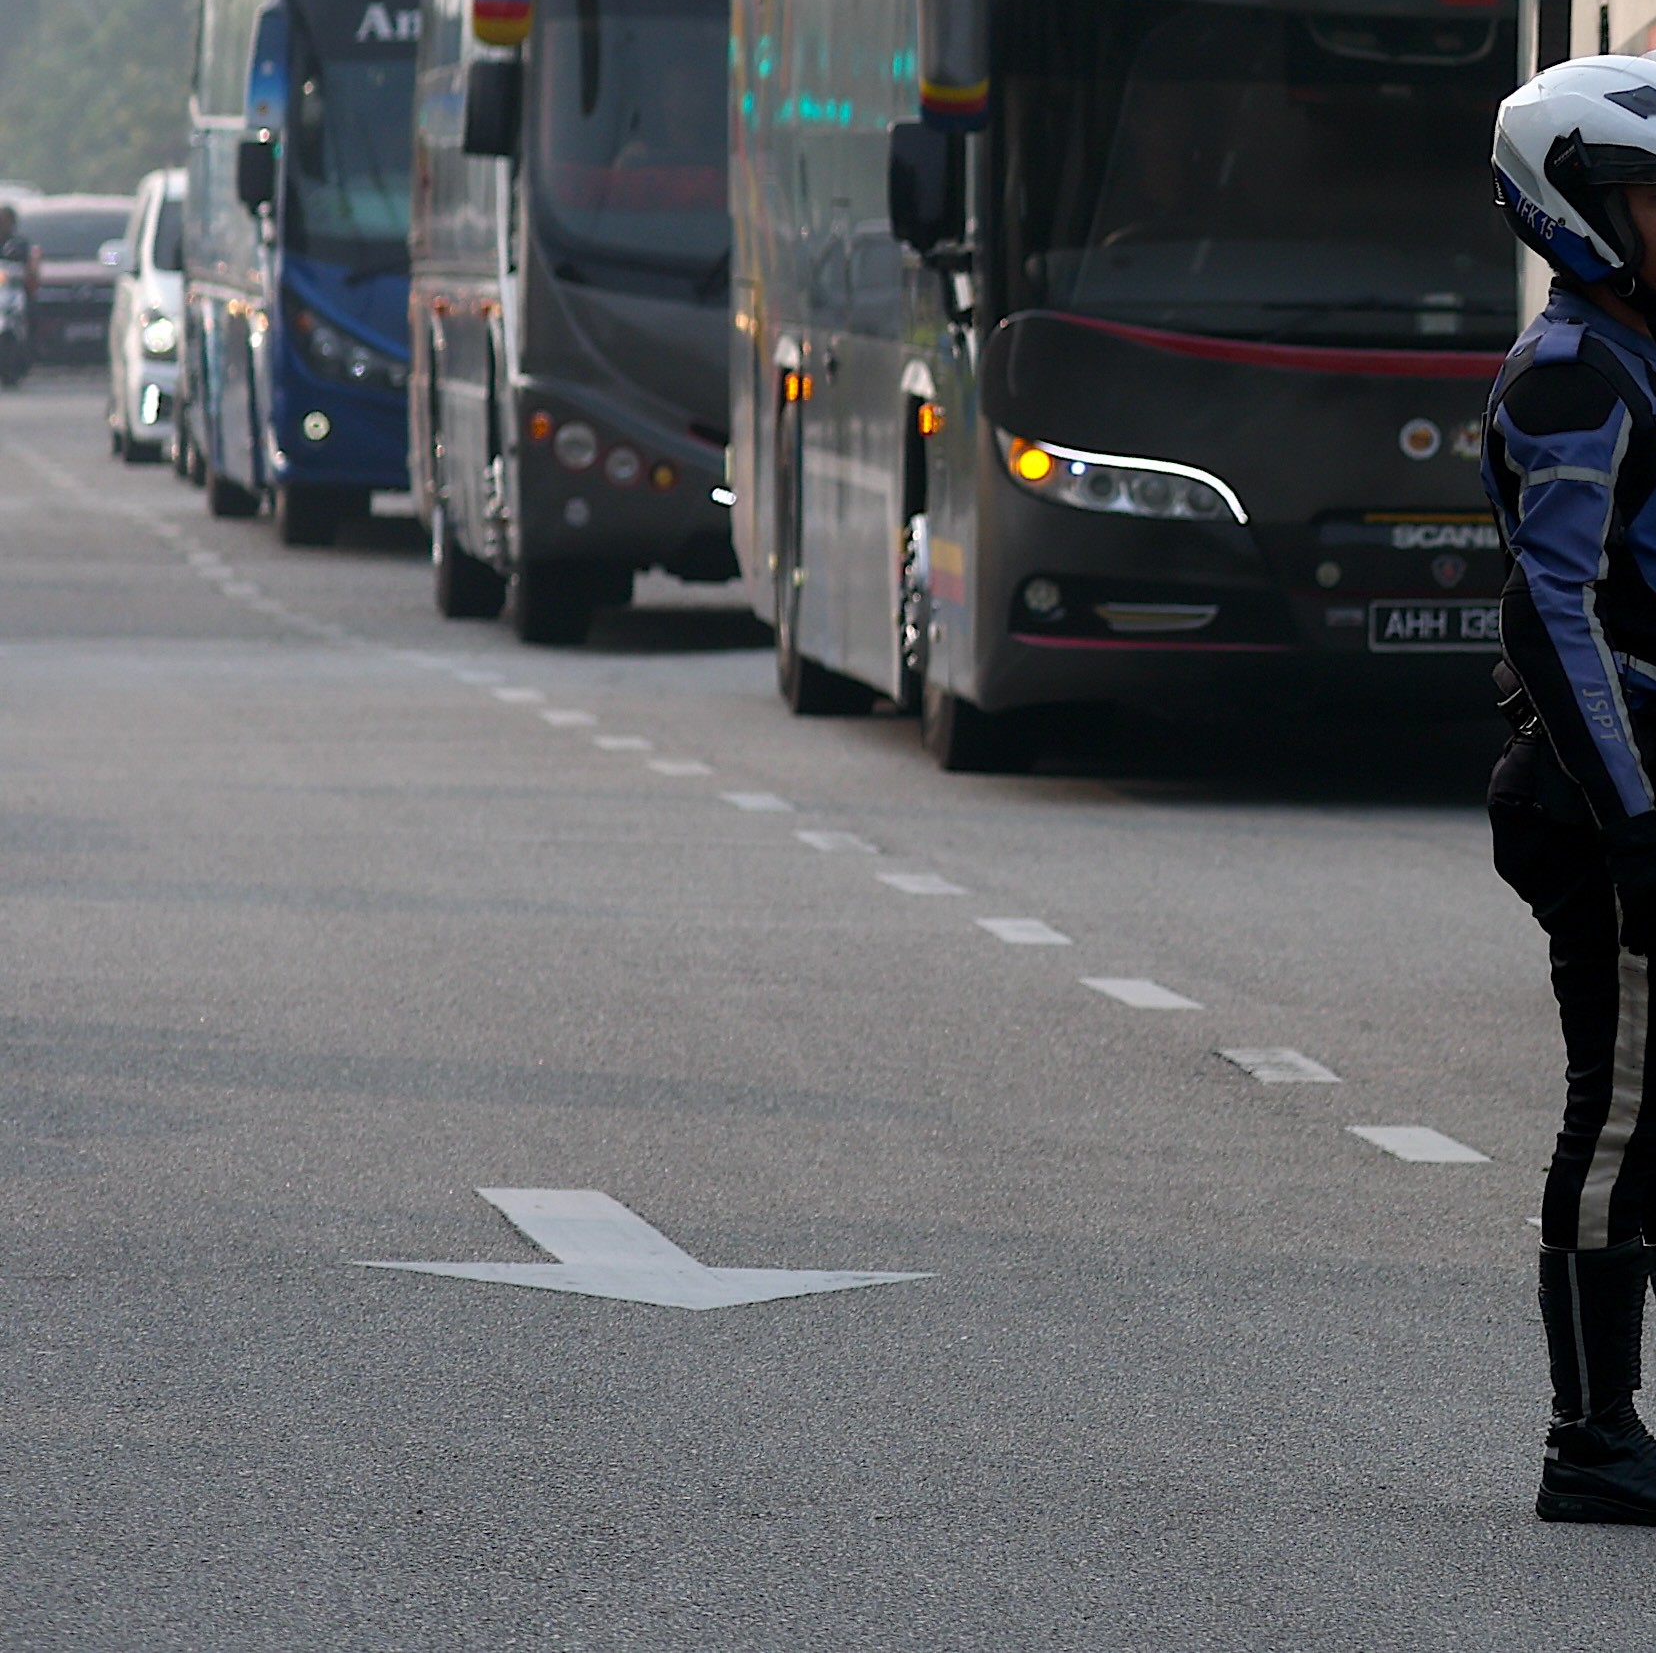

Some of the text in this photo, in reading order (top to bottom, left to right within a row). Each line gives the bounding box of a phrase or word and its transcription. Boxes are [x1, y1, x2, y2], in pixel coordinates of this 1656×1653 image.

[1515, 193, 1557, 241] TFK 15
[1384, 609, 1449, 640] AHH
